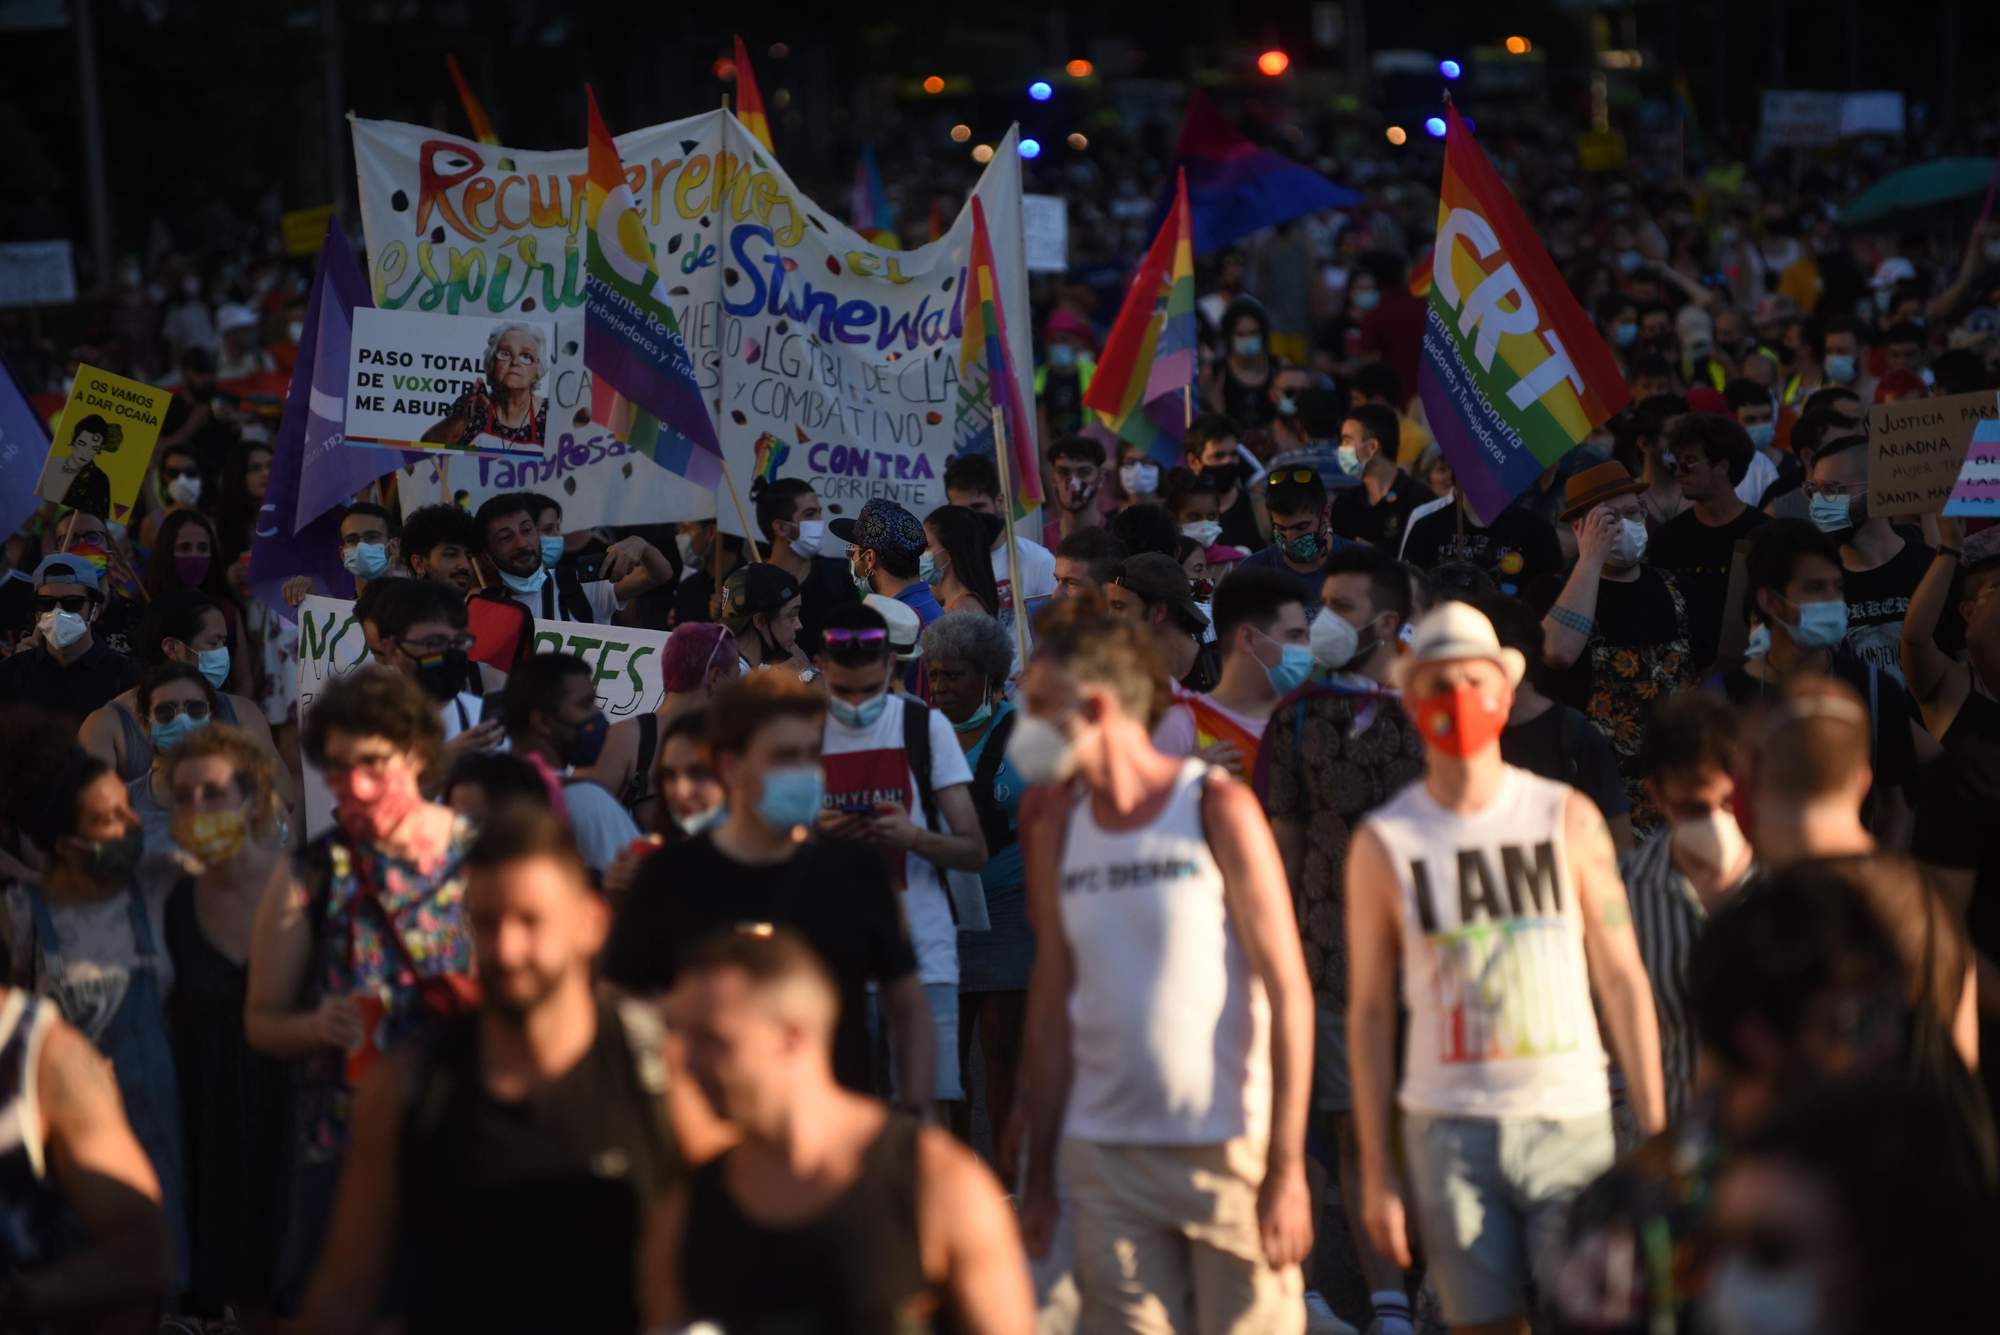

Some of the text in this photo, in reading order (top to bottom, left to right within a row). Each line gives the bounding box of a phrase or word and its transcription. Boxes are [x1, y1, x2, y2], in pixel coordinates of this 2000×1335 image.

[681, 233, 716, 274] de
[1433, 207, 1586, 412] CRT
[358, 348, 486, 374] PASO TOTAL
[357, 371, 384, 388] DE
[74, 391, 158, 427] A DAR OCAÑA
[90, 380, 154, 409] OS VAMOS
[355, 395, 385, 412] ME
[1451, 339, 1524, 450] Revolucionaria
[751, 378, 923, 447] COMBATIVO
[1459, 386, 1508, 465] Trabajadoras
[1879, 412, 1946, 435] JUSTICIA
[808, 442, 935, 480] CONTRA
[1879, 436, 1952, 460] ARIADNA
[1892, 463, 1933, 478] MUJER
[808, 476, 927, 504] CORRIENTE
[1876, 490, 1922, 506] SANTA
[1410, 840, 1563, 936] I AM
